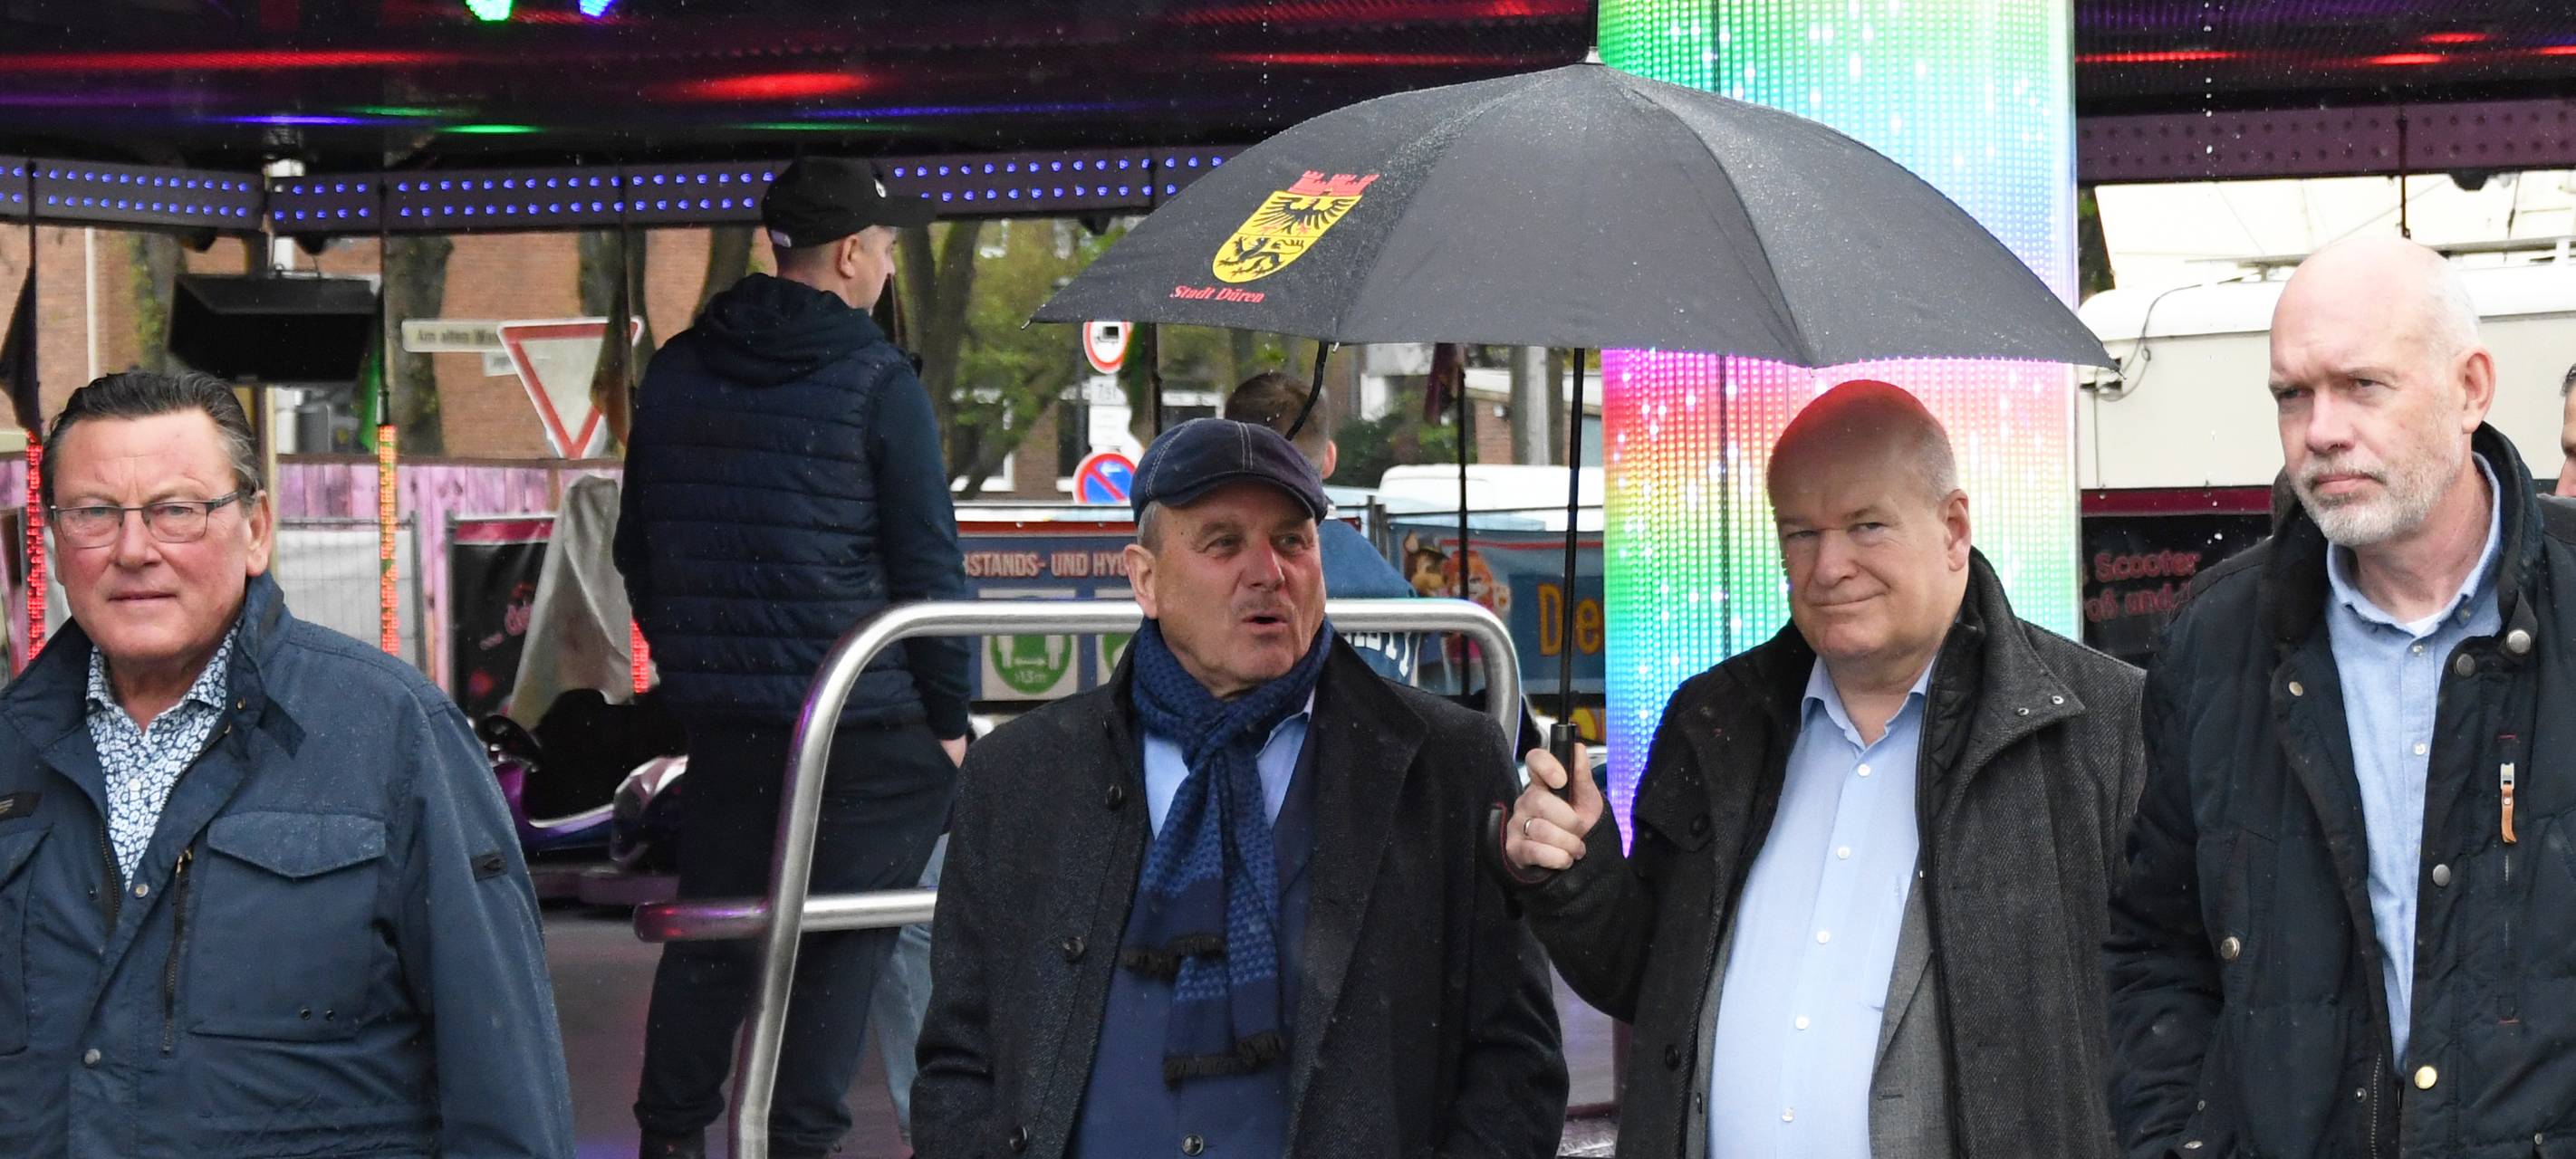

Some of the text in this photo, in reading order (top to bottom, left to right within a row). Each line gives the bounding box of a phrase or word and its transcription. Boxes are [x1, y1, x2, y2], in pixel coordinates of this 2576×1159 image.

[1169, 285, 1265, 303] Stadt Düren
[1051, 551, 1088, 577] UND
[2094, 549, 2201, 582] Scooter
